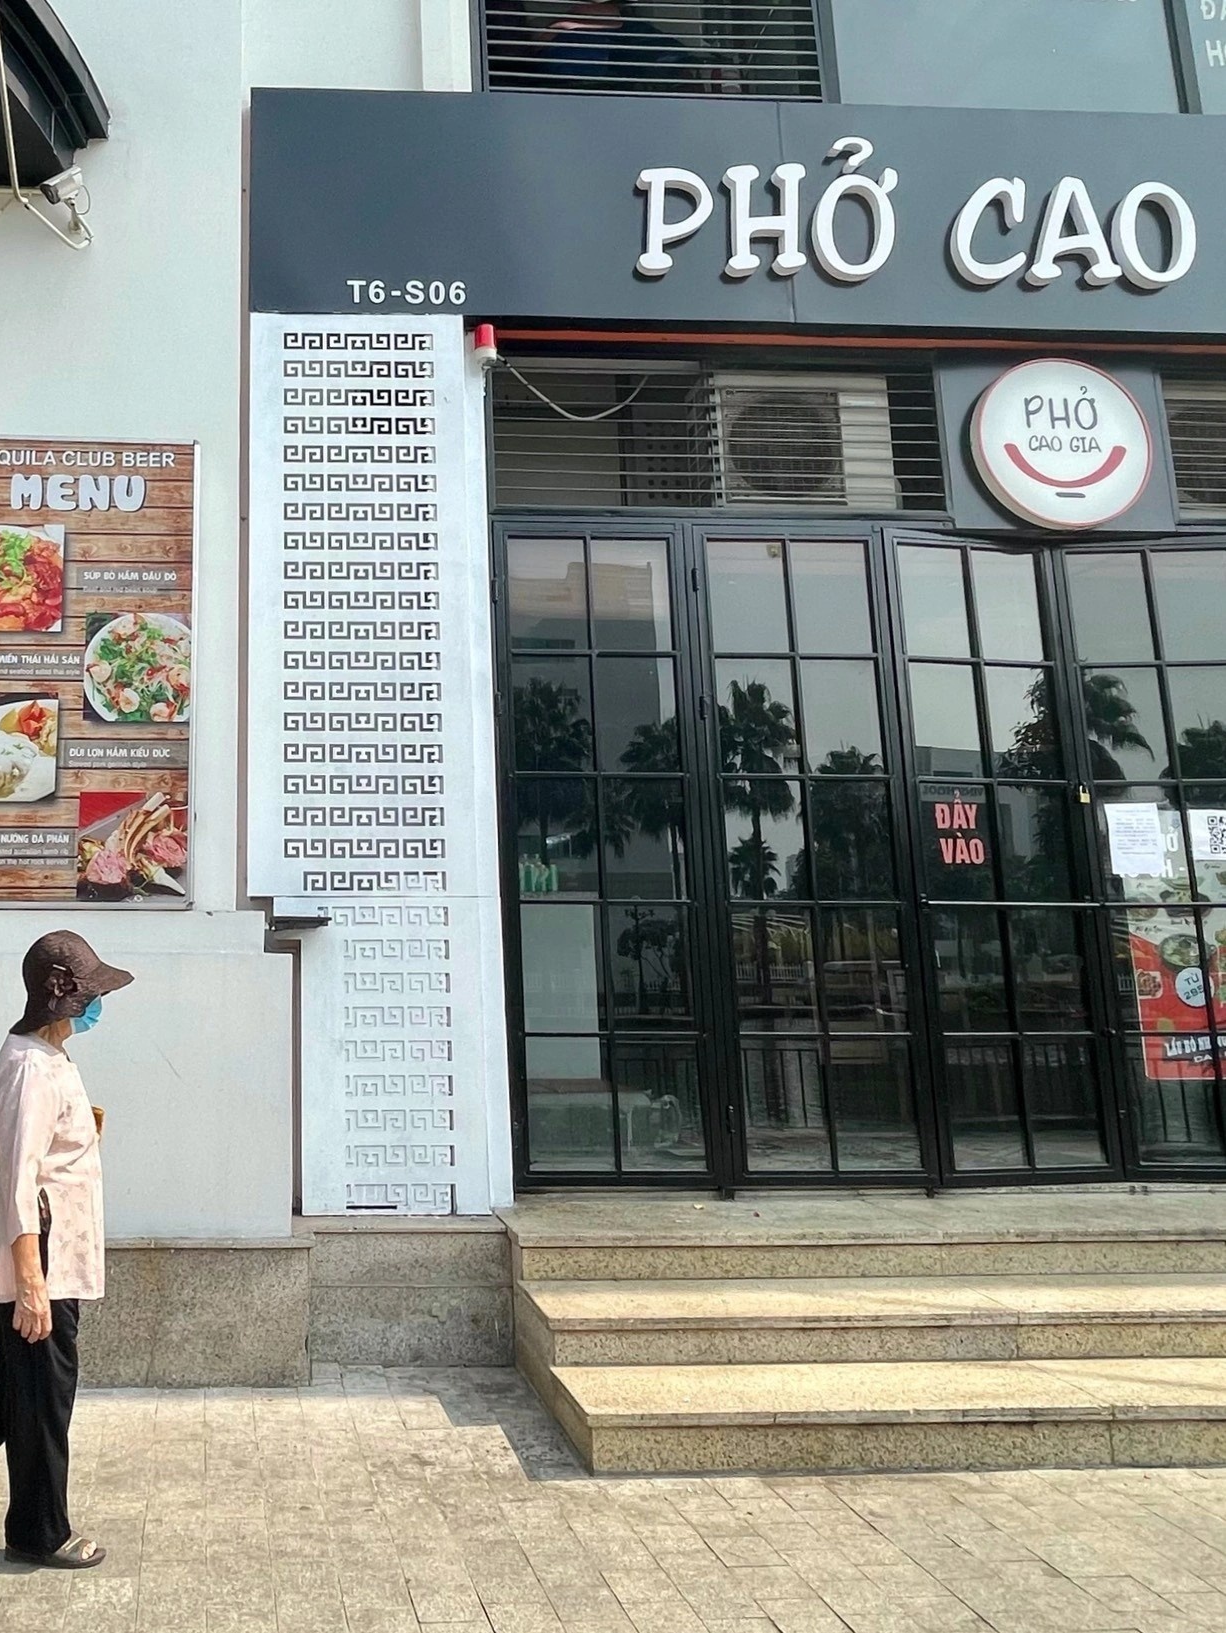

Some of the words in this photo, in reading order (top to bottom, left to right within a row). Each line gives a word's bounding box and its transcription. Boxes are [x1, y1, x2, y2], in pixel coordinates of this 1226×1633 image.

[636, 136, 898, 281] PHỞ
[951, 175, 1198, 289] CAO
[346, 279, 466, 305] T6-S06
[1024, 385, 1098, 431] PHỞ
[62, 451, 116, 467] CLUB
[121, 452, 175, 468] BEER
[1028, 435, 1063, 451] CAO
[1069, 436, 1102, 453] GIA
[10, 473, 147, 512] MENU
[21, 653, 41, 664] THÁI
[935, 789, 977, 829] ĐẨY
[939, 832, 985, 864] VÀO
